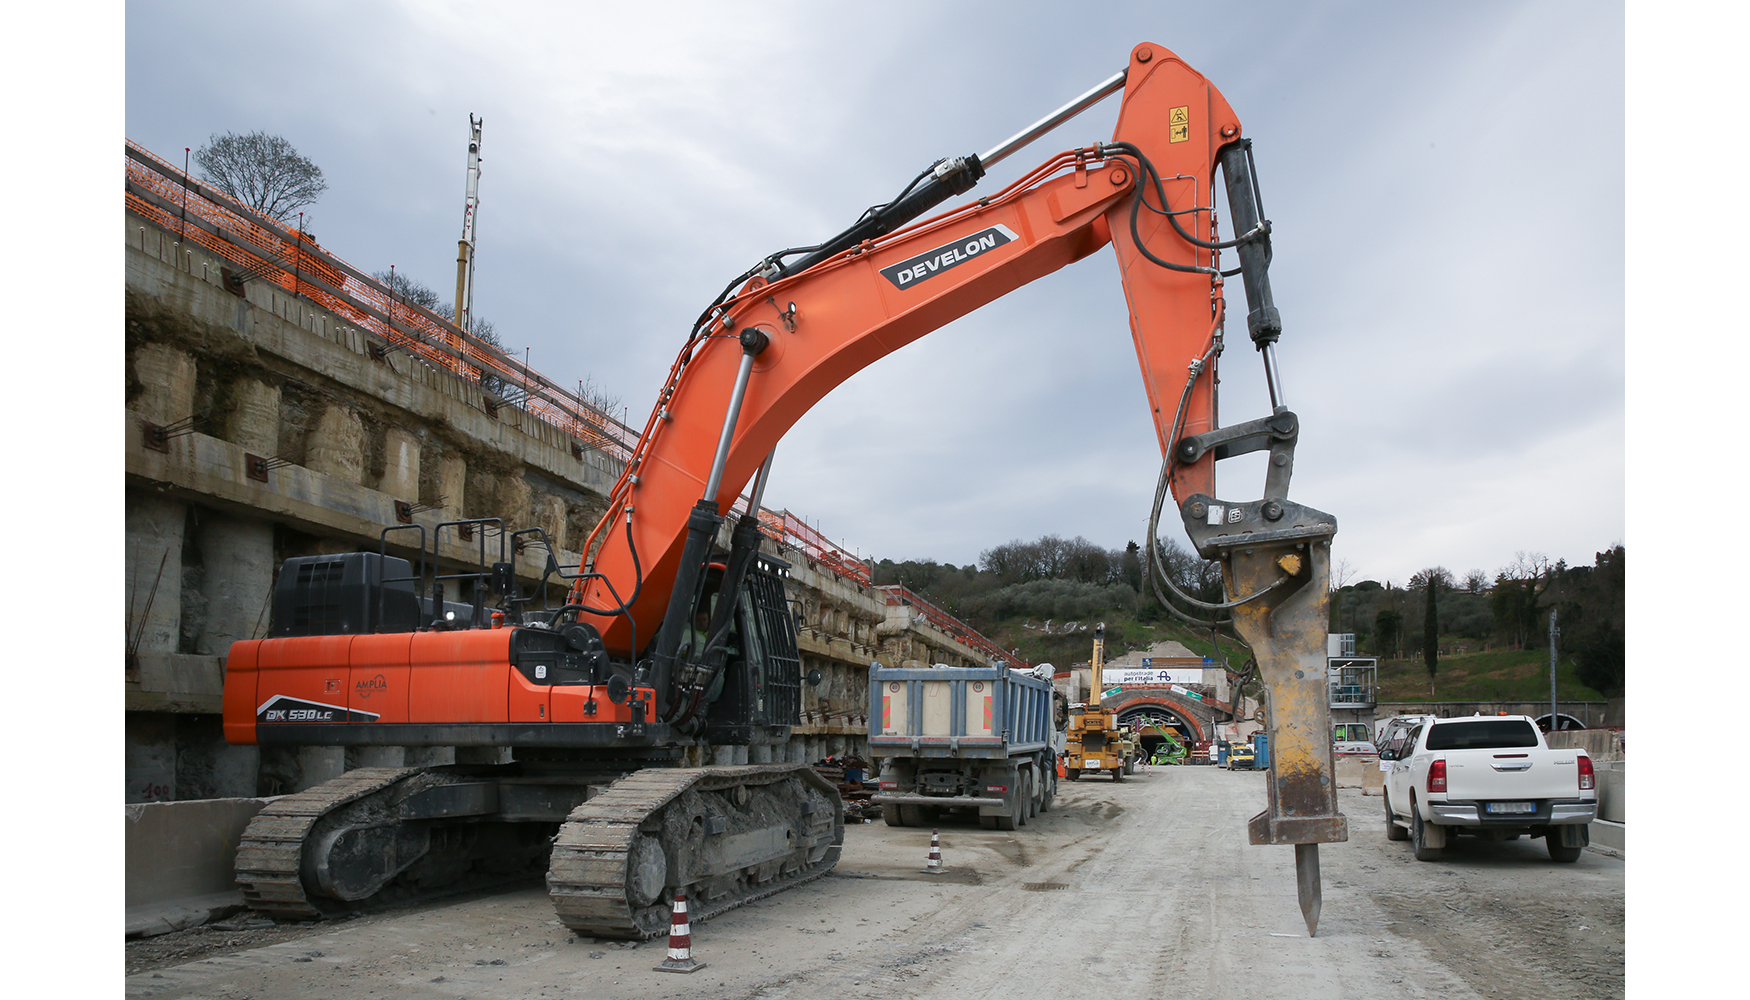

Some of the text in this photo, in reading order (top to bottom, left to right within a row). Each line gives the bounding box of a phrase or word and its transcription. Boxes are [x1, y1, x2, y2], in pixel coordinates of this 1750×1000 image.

[897, 233, 996, 285] DEVELON
[355, 680, 387, 689] AMPLIA
[266, 709, 286, 720] DX
